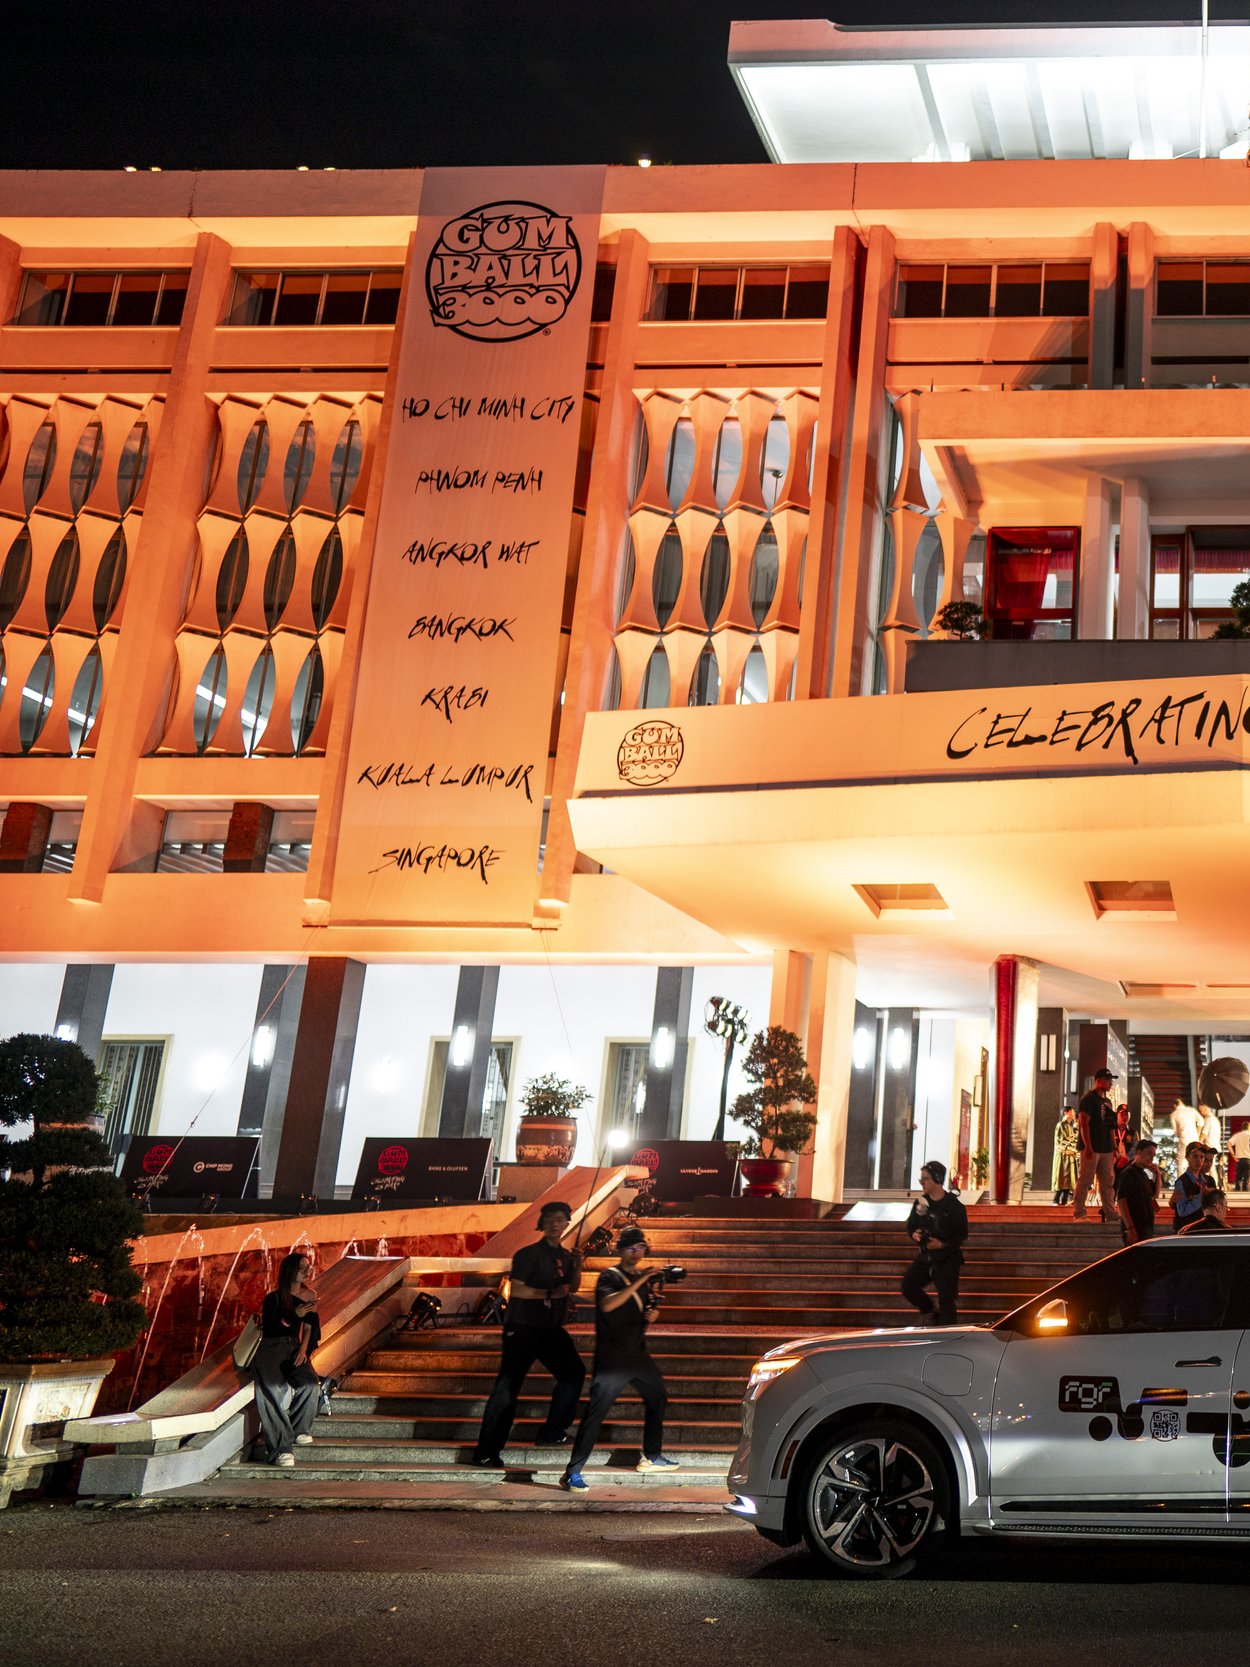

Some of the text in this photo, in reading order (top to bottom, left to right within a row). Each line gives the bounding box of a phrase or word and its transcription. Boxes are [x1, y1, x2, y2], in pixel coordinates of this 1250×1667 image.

[442, 212, 574, 252] GUM
[435, 251, 571, 289] BALL
[430, 288, 567, 327] 3000
[402, 394, 575, 424] HO CHI MINH CITY
[415, 465, 544, 494] PHNOM PENH
[402, 537, 541, 569] ANGKOR WAT
[408, 612, 518, 643] BANGKOK
[420, 685, 489, 724] KRABI
[624, 727, 682, 746] GUM
[621, 744, 679, 763] BALL
[357, 762, 534, 804] KUALA LUMPUR
[619, 761, 677, 781] 3000
[368, 841, 505, 886] SINGAPORE
